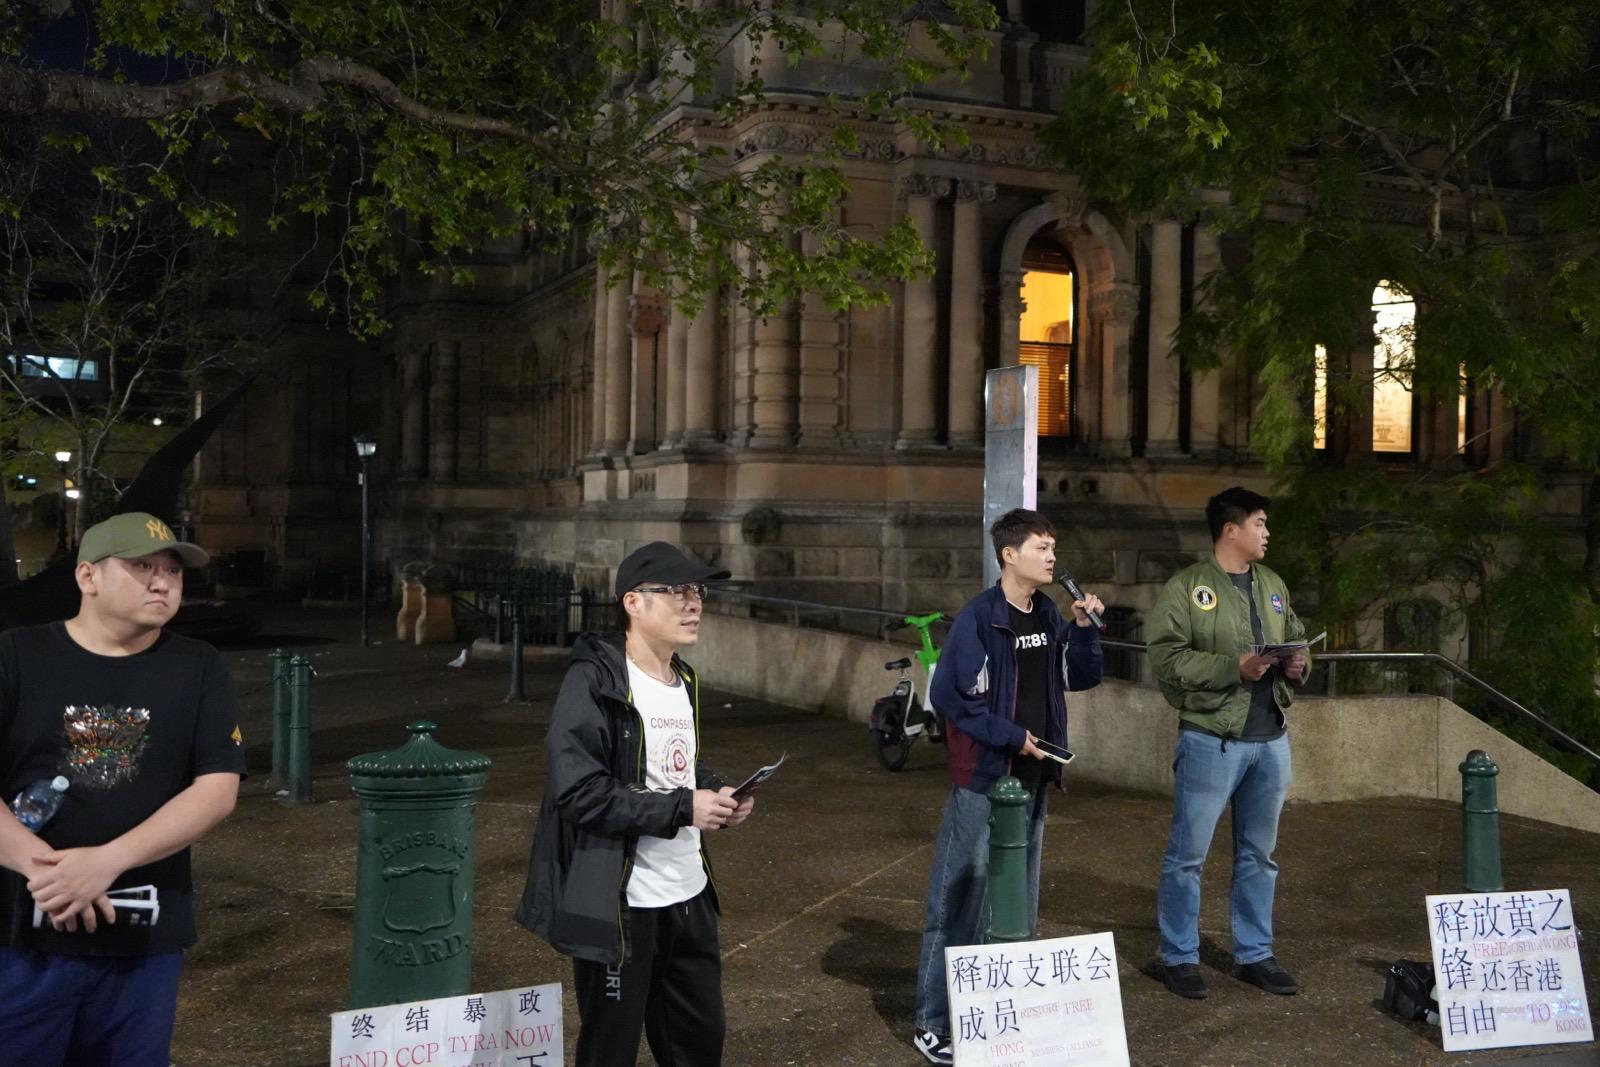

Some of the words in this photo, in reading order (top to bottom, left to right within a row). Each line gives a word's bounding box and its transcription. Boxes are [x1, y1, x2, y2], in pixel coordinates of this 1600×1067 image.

[1433, 893, 1572, 943] 释放黄之
[1543, 934, 1577, 951] WONG
[951, 946, 1112, 993] 释放支联会
[1440, 947, 1563, 992] 锋还香港
[351, 989, 542, 1039] 终结暴政
[958, 998, 1020, 1044] 成员
[1063, 998, 1095, 1015] FREE
[1447, 1000, 1497, 1036] 自由
[1526, 1002, 1551, 1024] TO
[1555, 1016, 1586, 1033] KONG
[395, 1042, 440, 1067] CCP
[448, 1033, 498, 1053] TYRA
[505, 1024, 556, 1050] NOW
[990, 1040, 1025, 1057] HONG
